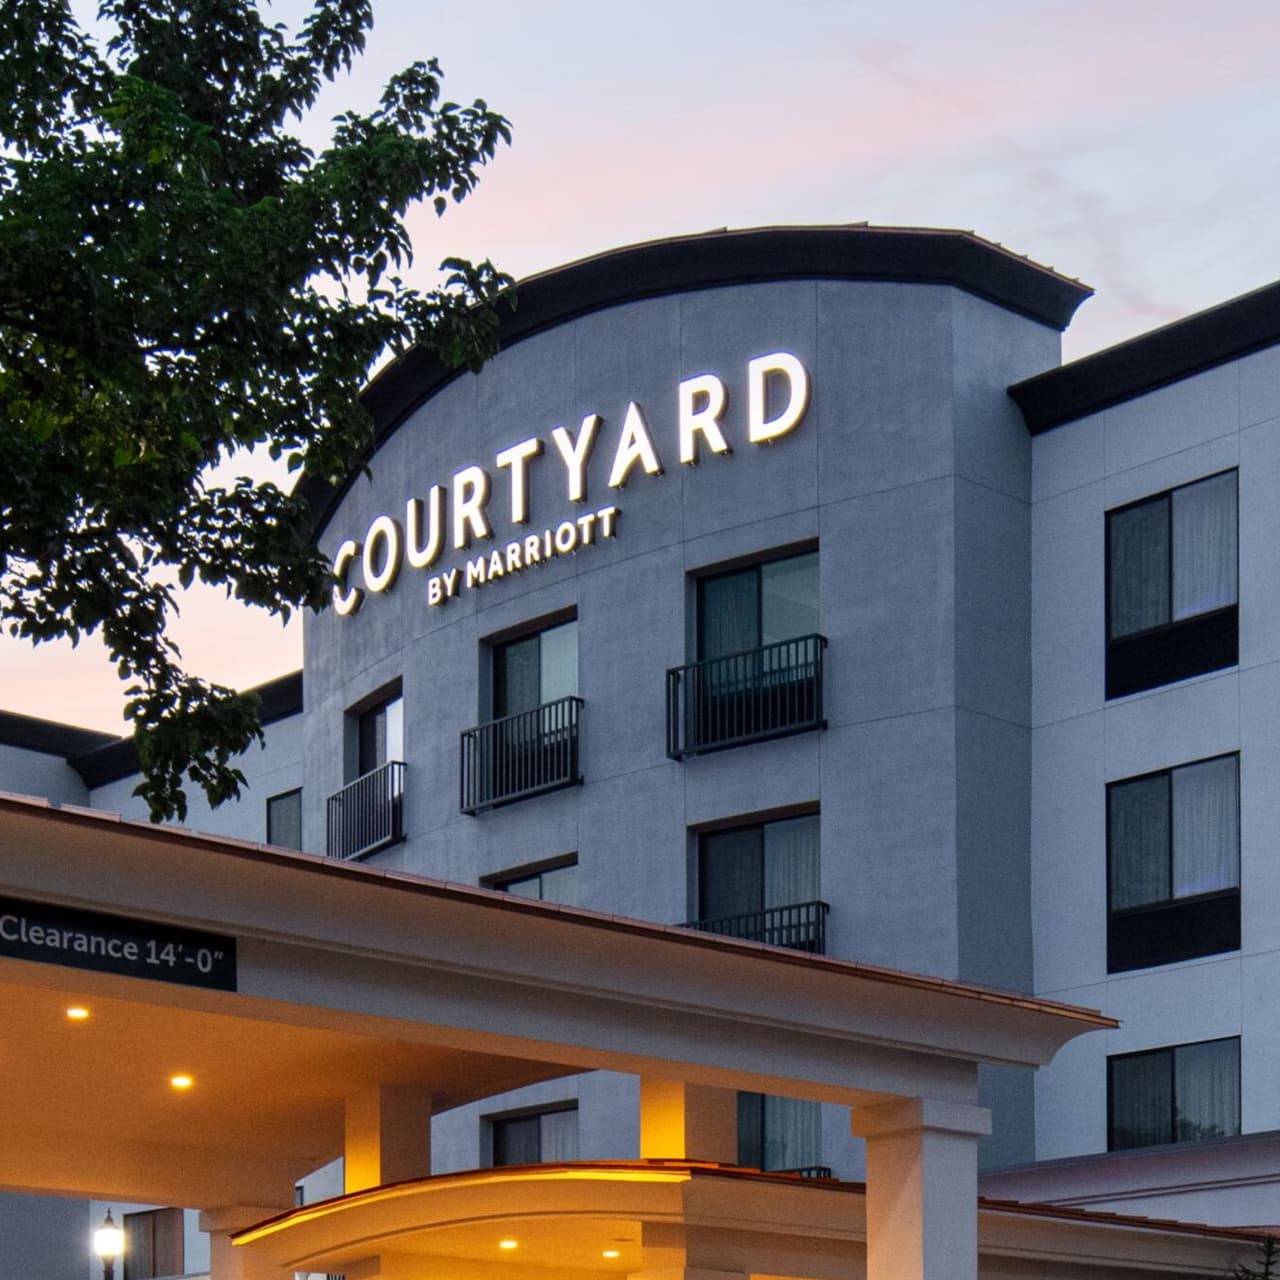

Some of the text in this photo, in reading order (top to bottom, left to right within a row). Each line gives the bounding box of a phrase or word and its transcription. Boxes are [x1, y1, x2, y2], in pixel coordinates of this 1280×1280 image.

[333, 350, 811, 616] COURTYARD
[428, 506, 617, 606] BY MARRIOTT
